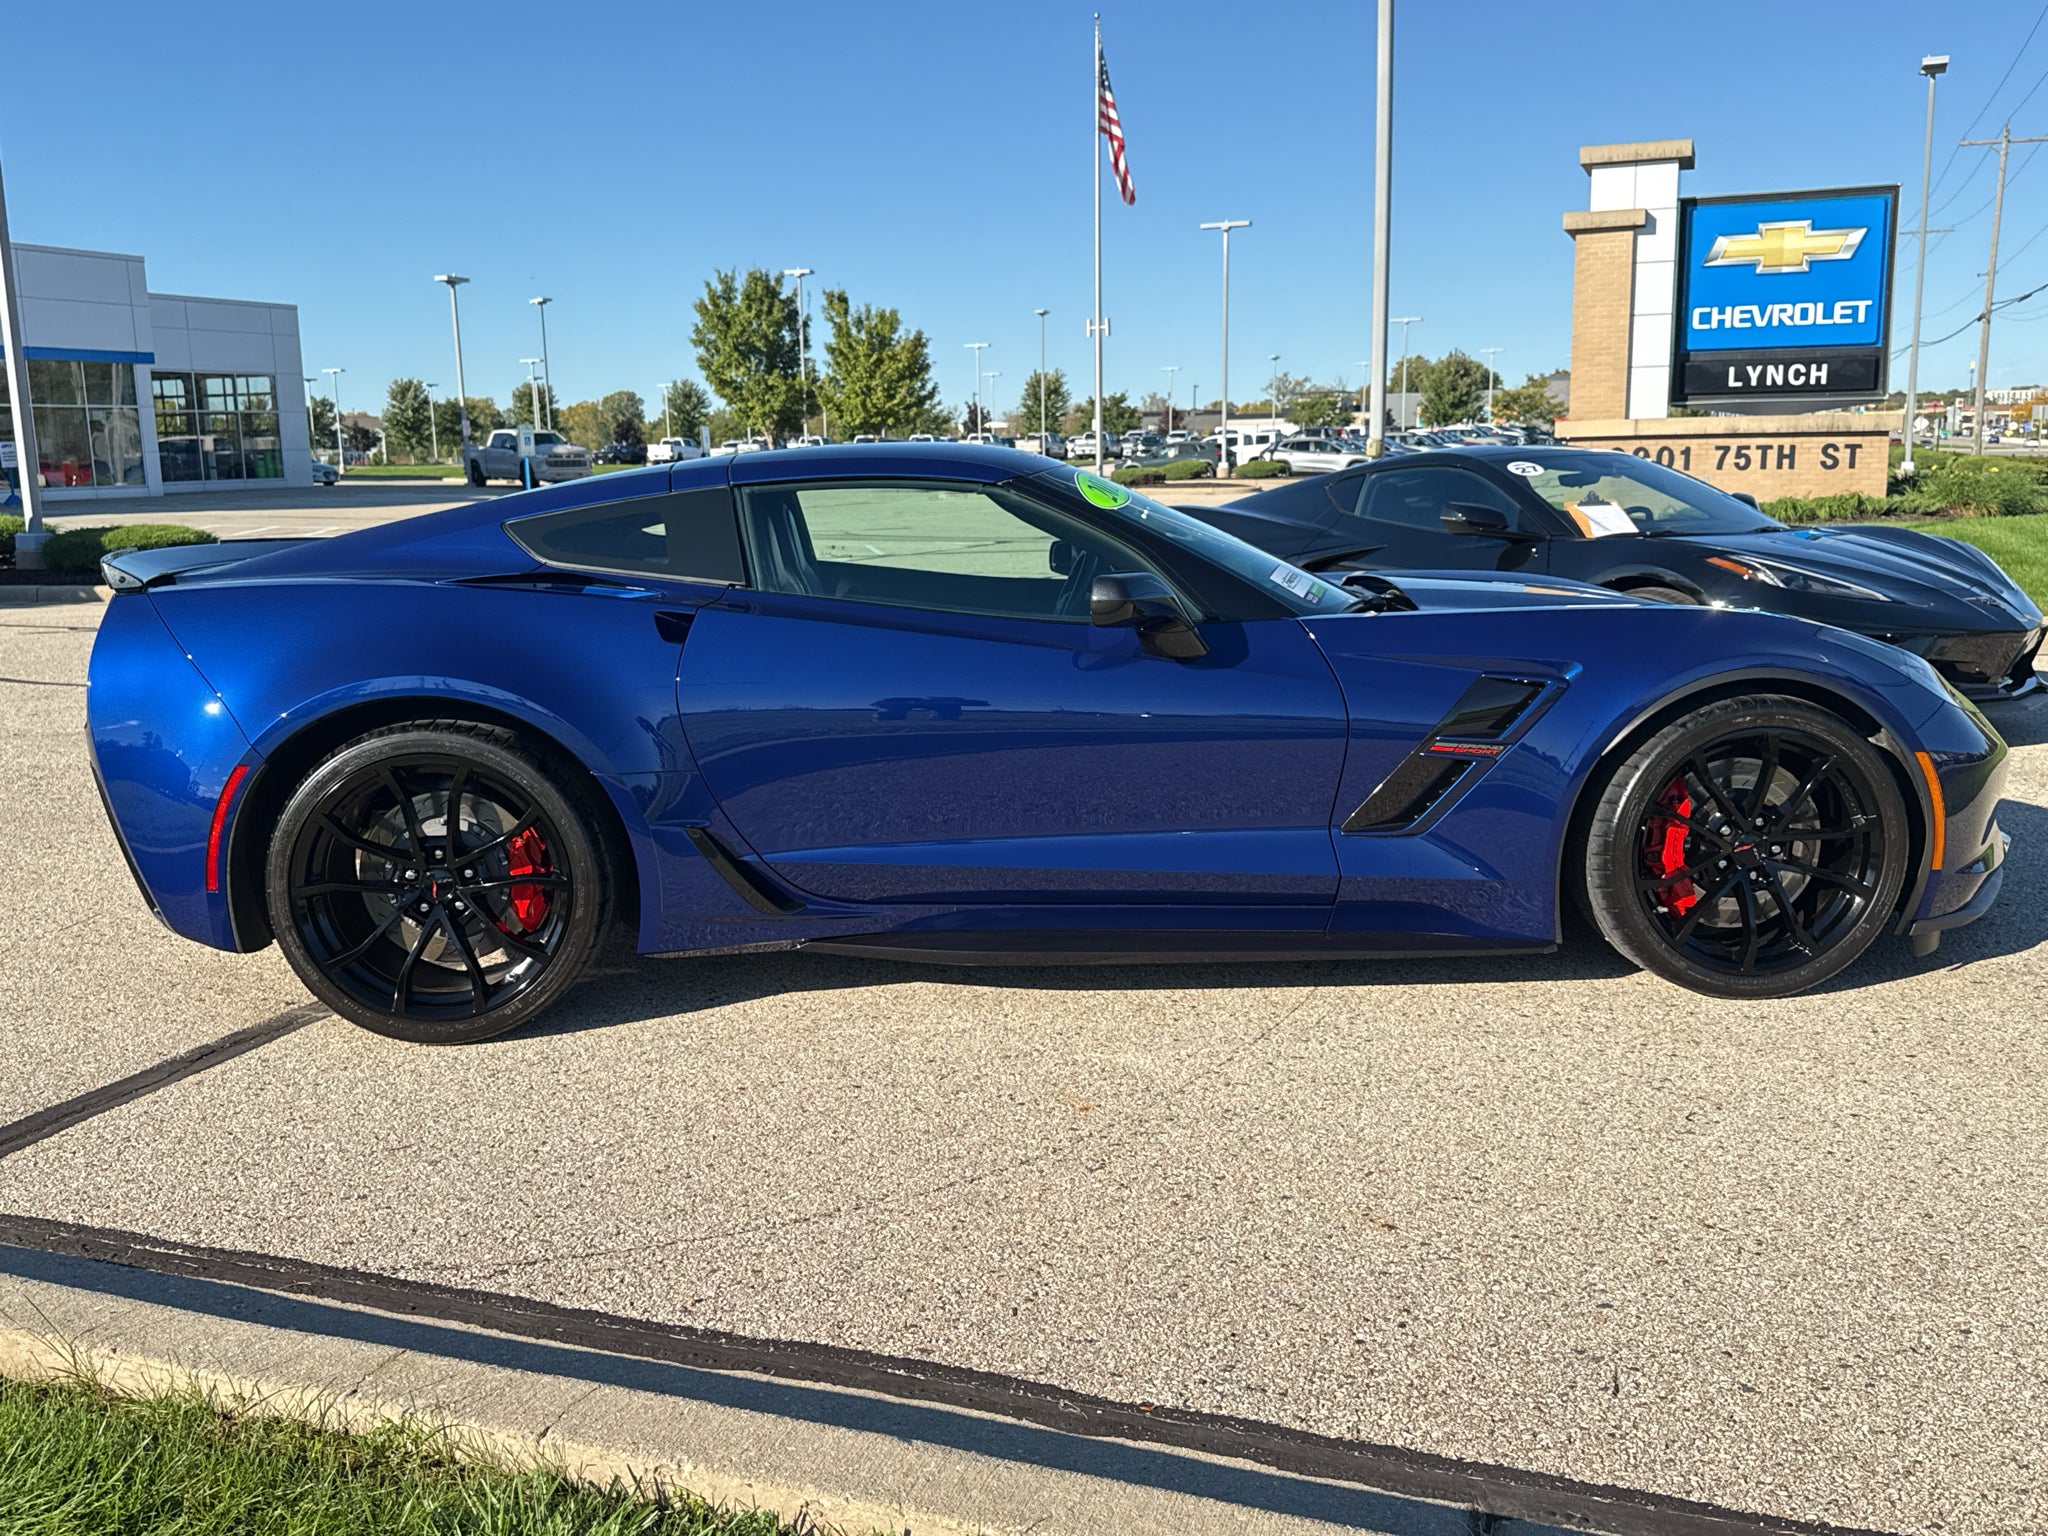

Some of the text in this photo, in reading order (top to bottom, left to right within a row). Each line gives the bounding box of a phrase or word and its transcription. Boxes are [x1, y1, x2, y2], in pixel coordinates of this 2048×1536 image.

[1692, 300, 1873, 330] CHEVROLET
[1727, 363, 1829, 388] LYNCH
[1714, 444, 1797, 471] 75TH
[1819, 443, 1863, 470] ST
